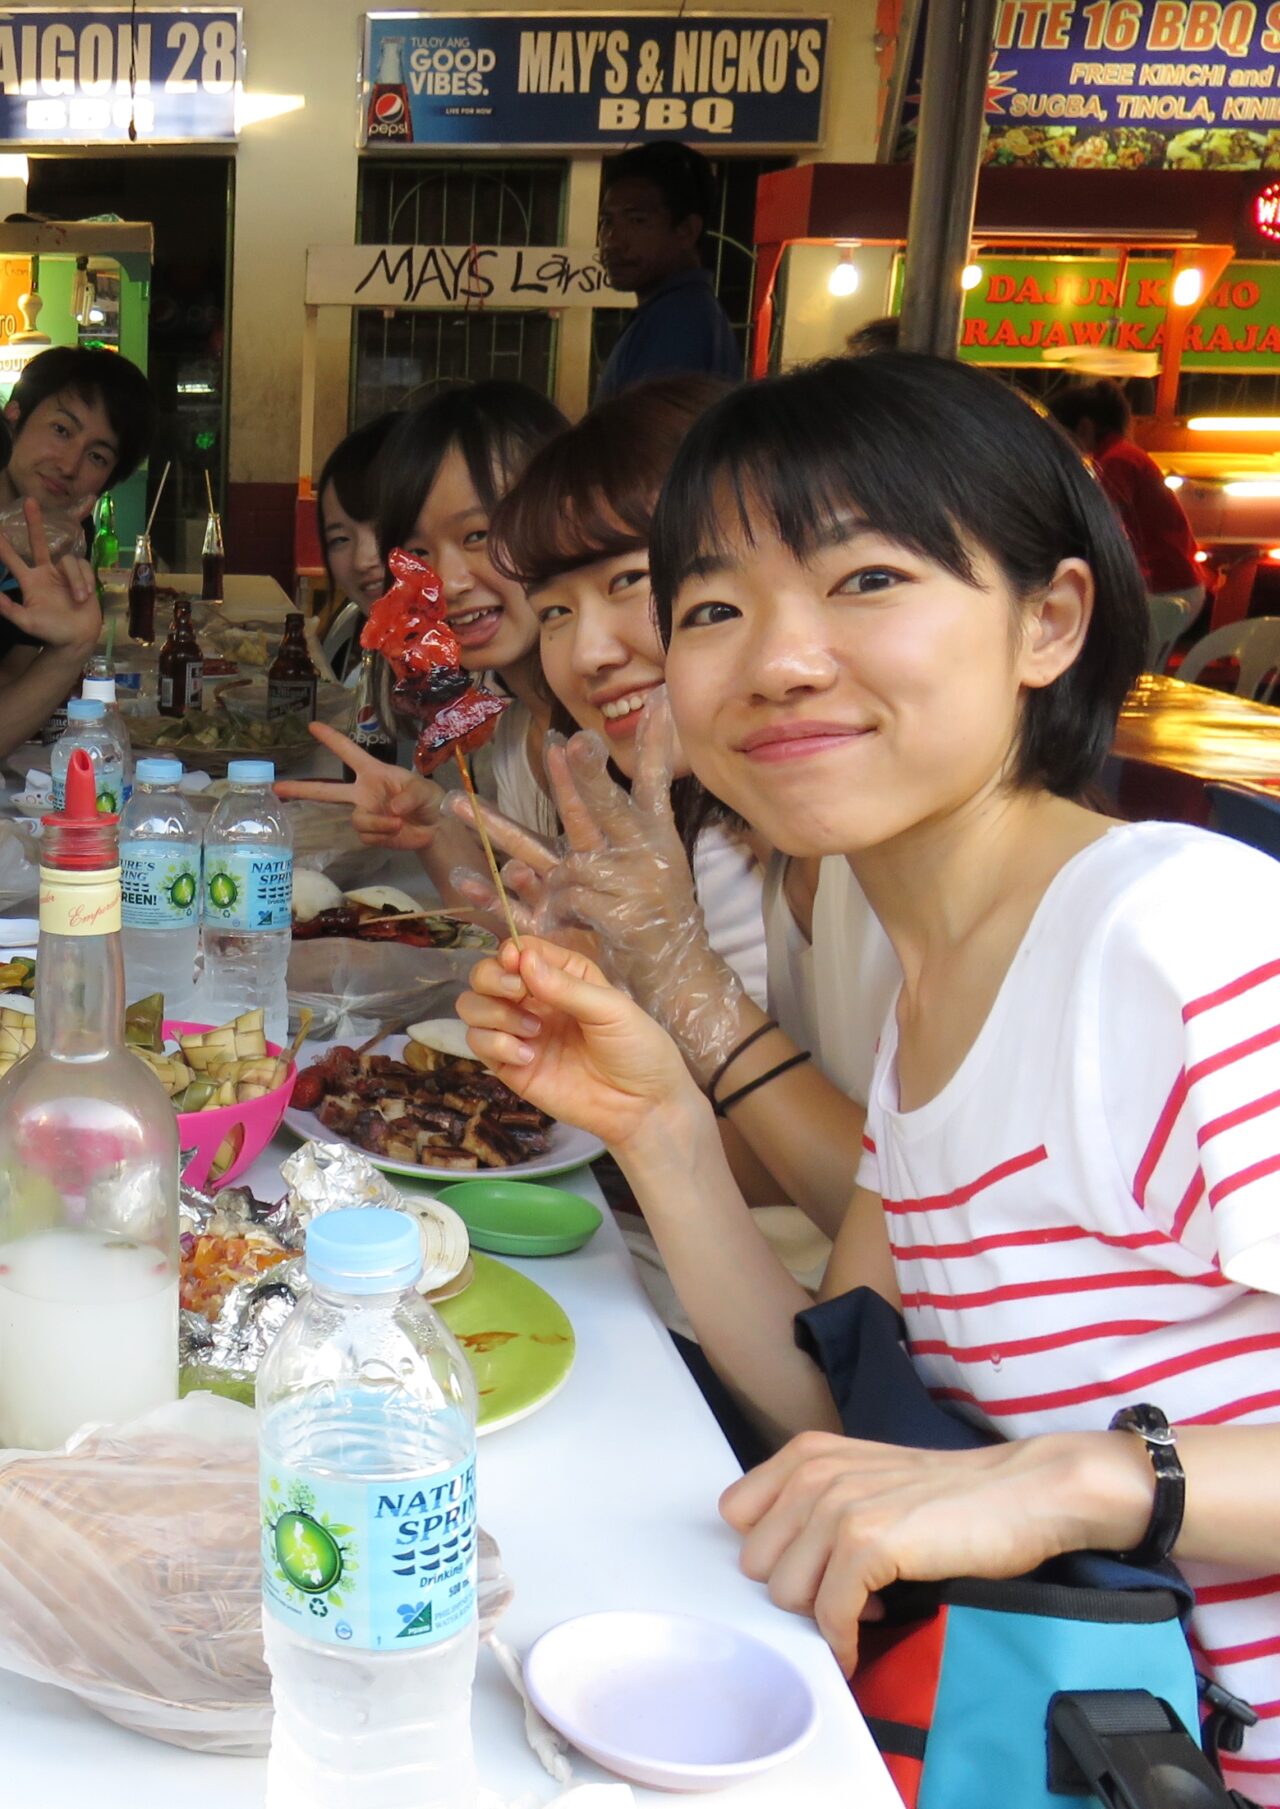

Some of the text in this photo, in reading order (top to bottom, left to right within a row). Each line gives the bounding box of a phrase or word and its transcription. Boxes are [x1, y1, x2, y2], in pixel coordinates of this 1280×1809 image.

[411, 37, 470, 48] TULOY ANG
[992, 0, 1074, 49] ITE
[1082, 0, 1145, 50] 16
[1146, 0, 1257, 57] BBQ
[164, 22, 237, 97] 28
[410, 48, 496, 72] GOOD
[518, 28, 821, 95] MAY'S & NICKO'S
[409, 71, 489, 96] VIBES.
[1070, 62, 1275, 88] FREE KIMCHI and
[598, 97, 735, 134] BBQ
[1009, 94, 1108, 122] SUGBA,
[1116, 95, 1215, 123] TINOLA,
[368, 120, 408, 136] pepsi
[354, 246, 498, 301] MAYS
[961, 318, 1108, 348] RAJAW
[419, 1562, 463, 1588] Drinking
